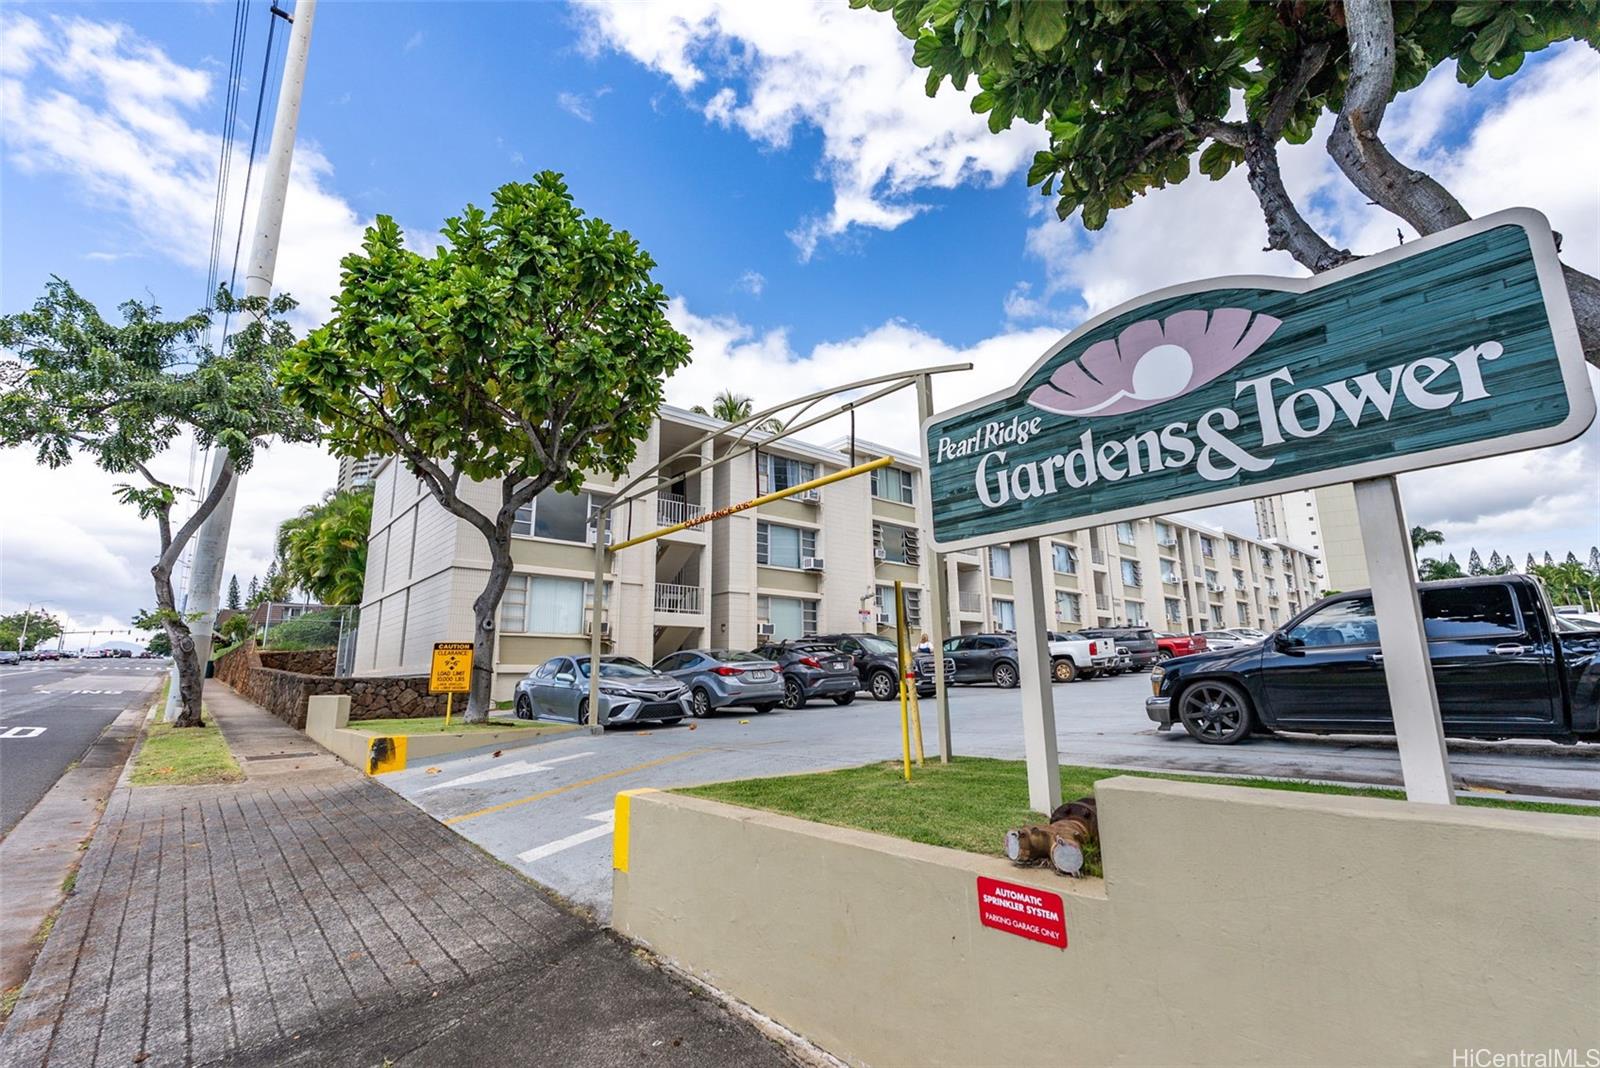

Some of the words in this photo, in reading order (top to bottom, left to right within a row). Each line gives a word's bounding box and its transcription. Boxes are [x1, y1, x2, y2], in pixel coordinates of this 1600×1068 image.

[1235, 340, 1504, 447] Tower
[936, 427, 981, 464] Pearl
[984, 415, 1042, 449] Ridge
[1196, 407, 1276, 481] &
[975, 422, 1195, 508] Gardens
[684, 506, 733, 528] CLEARANCE
[982, 894, 1025, 913] SPRINKLER
[1026, 905, 1060, 922] SYSTEM
[995, 887, 1042, 906] AUTOMATIC
[985, 911, 1012, 926] PARKING
[1012, 920, 1040, 935] GARAGE
[1040, 927, 1060, 940] ONLY
